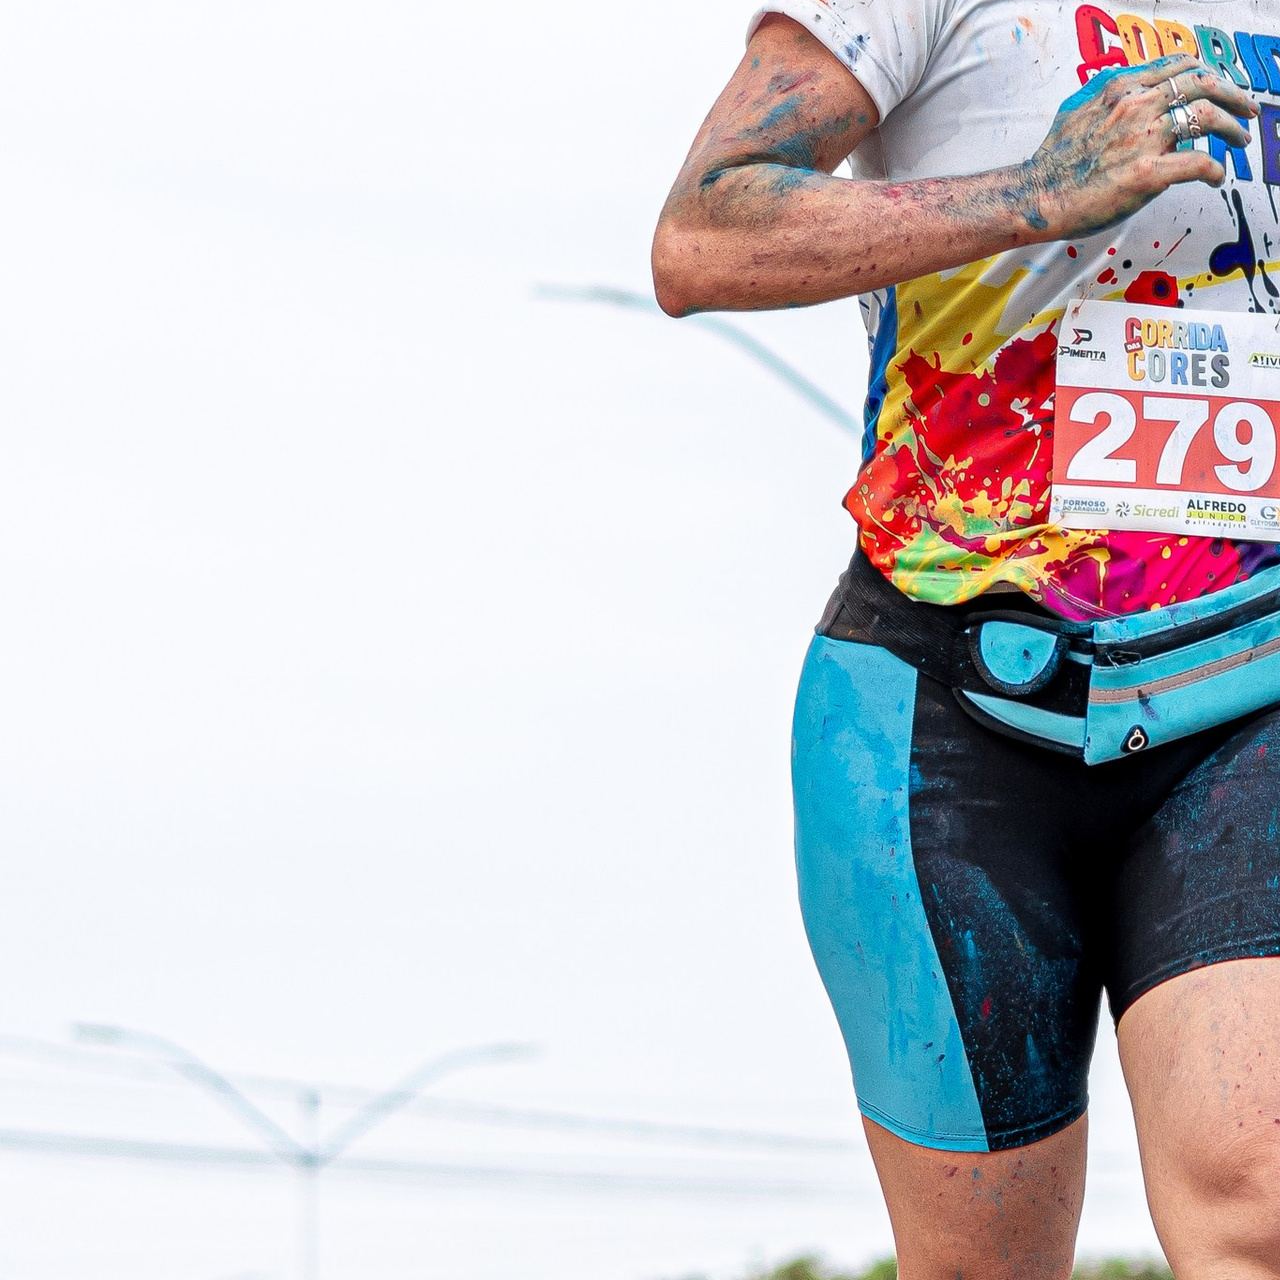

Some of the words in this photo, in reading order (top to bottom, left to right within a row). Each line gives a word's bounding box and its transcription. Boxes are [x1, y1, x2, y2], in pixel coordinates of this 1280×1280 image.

[1125, 317, 1229, 353] CORRIDA
[1058, 345, 1106, 360] PIMENTA
[1125, 341, 1142, 351] DAS
[1127, 349, 1230, 388] CORES
[1066, 392, 1277, 492] 279
[1063, 499, 1106, 508] FORMOSO
[1133, 504, 1180, 518] Sicredi
[1187, 499, 1247, 514] ALFREDO
